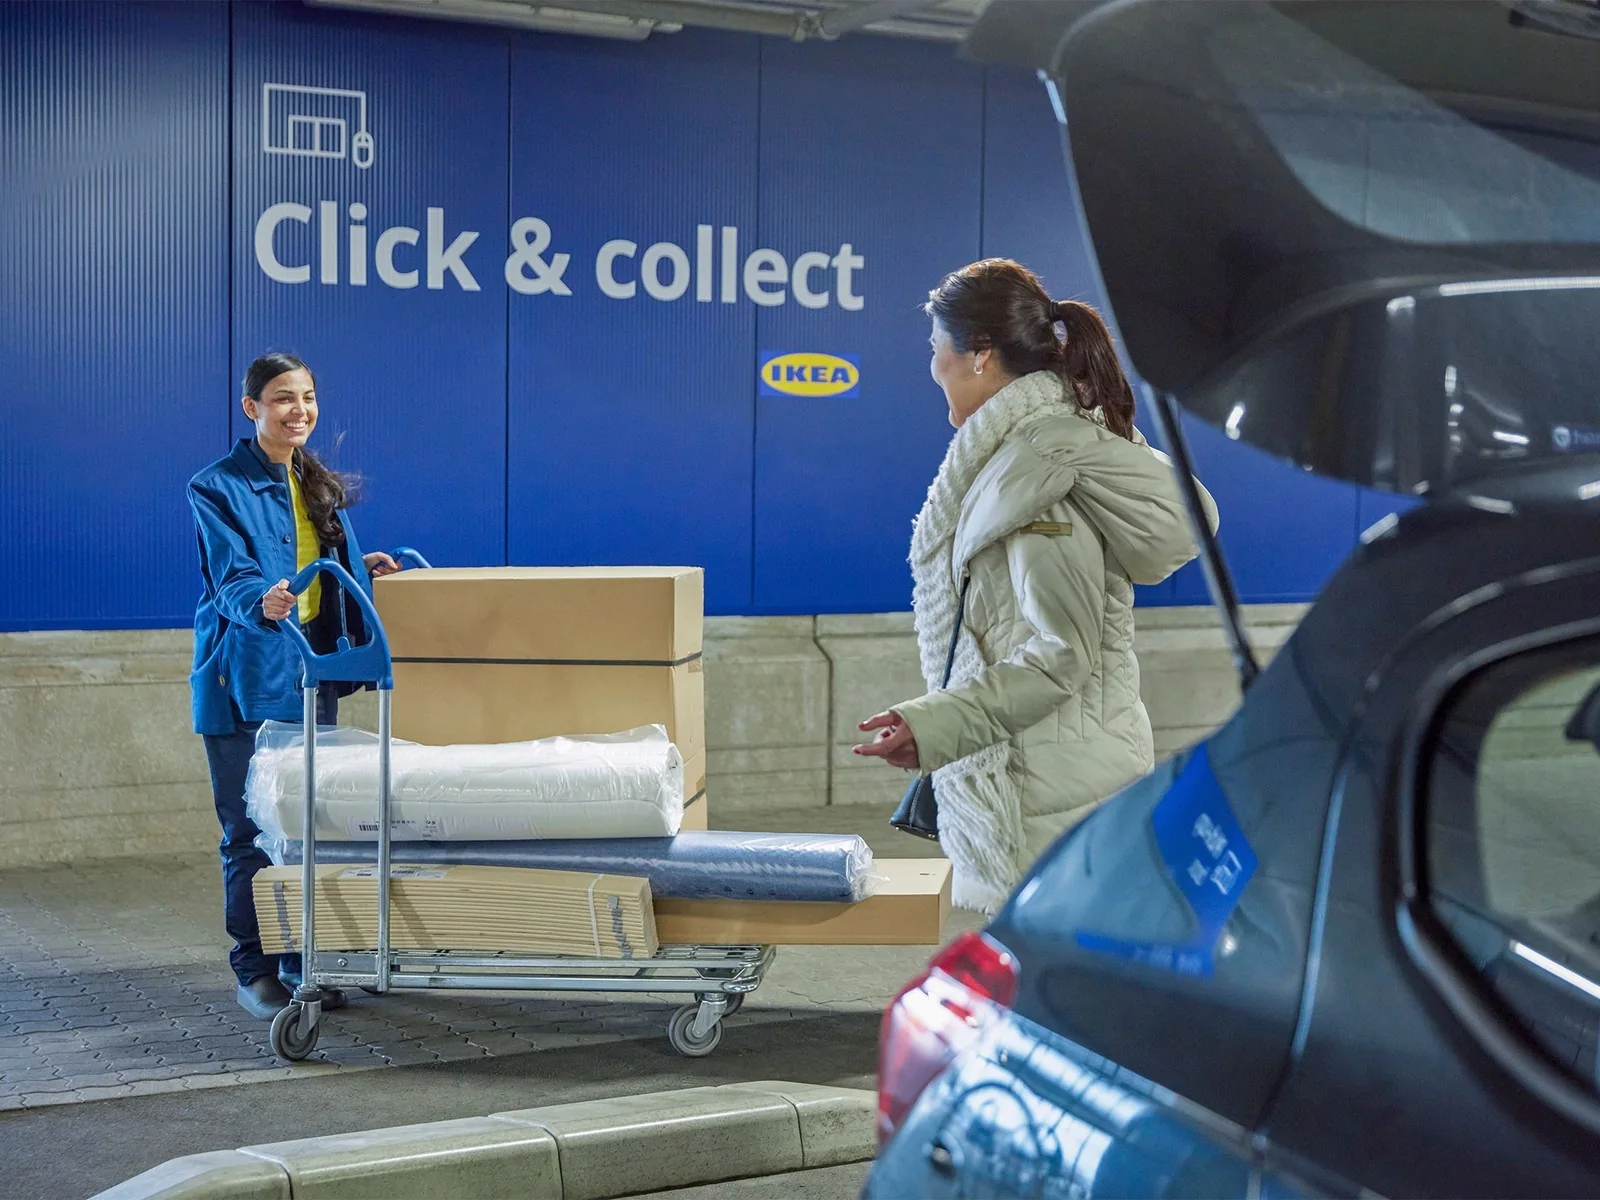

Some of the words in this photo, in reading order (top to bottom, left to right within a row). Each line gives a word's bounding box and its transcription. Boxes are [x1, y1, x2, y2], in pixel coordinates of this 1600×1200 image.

[254, 200, 481, 292] Click
[504, 217, 573, 296] &
[595, 224, 865, 311] collect
[771, 364, 851, 384] IKEA
